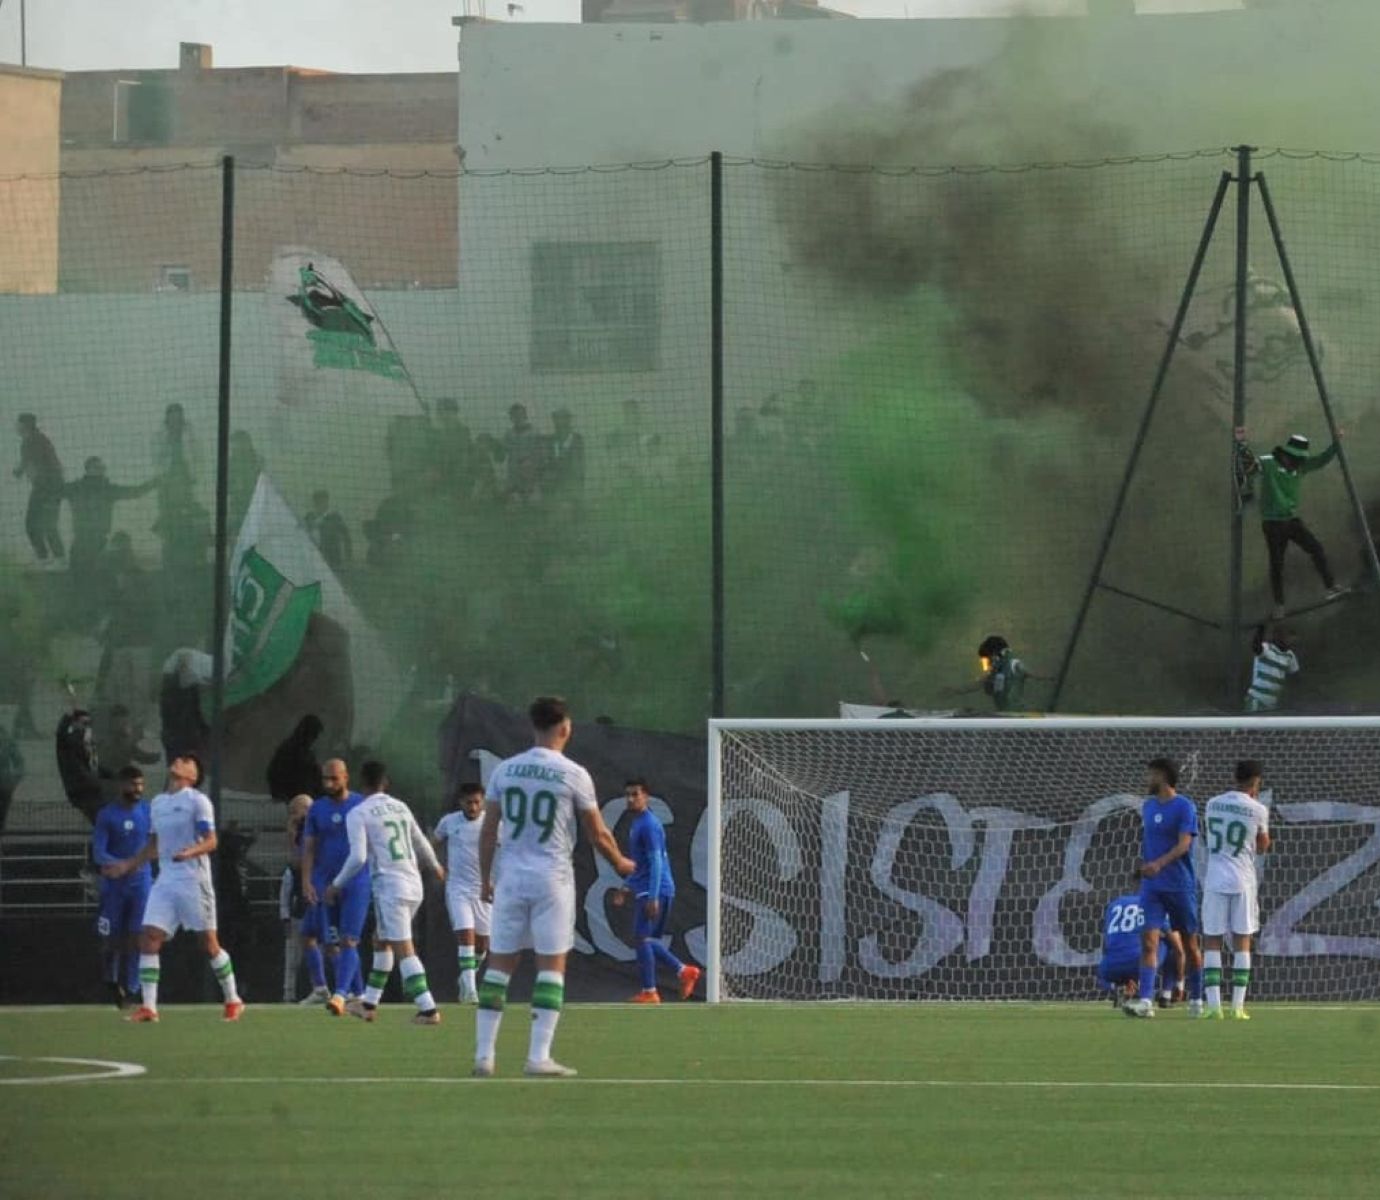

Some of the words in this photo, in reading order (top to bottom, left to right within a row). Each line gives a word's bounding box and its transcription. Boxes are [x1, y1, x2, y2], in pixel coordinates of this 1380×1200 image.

[505, 786, 558, 843] 99
[383, 820, 411, 861] 21
[1207, 816, 1247, 857] 59
[1107, 904, 1138, 934] 28
